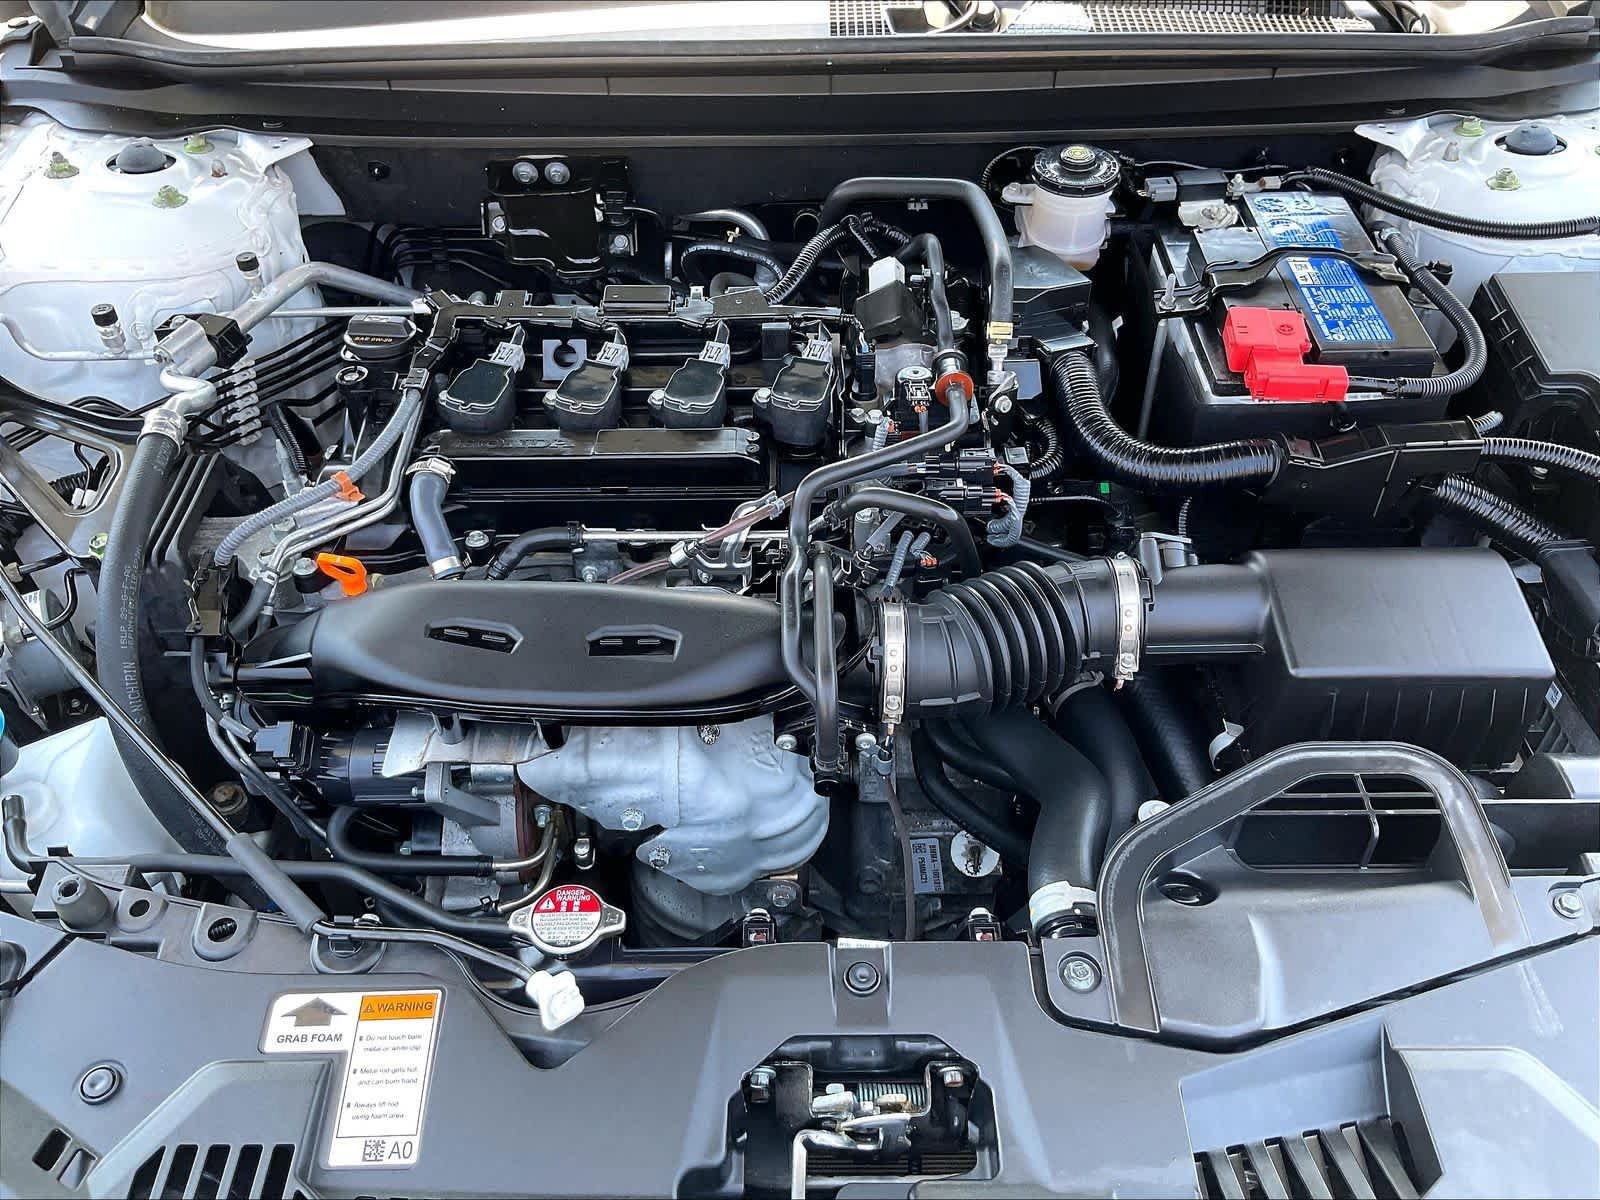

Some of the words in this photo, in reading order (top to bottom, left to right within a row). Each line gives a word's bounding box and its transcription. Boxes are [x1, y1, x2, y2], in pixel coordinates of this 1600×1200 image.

[122, 662, 144, 713] NICHIRIN
[377, 1002, 433, 1013] WARNING
[276, 1034, 308, 1044] GRAB
[310, 1033, 343, 1043] FOAM
[388, 1140, 413, 1160] A0
